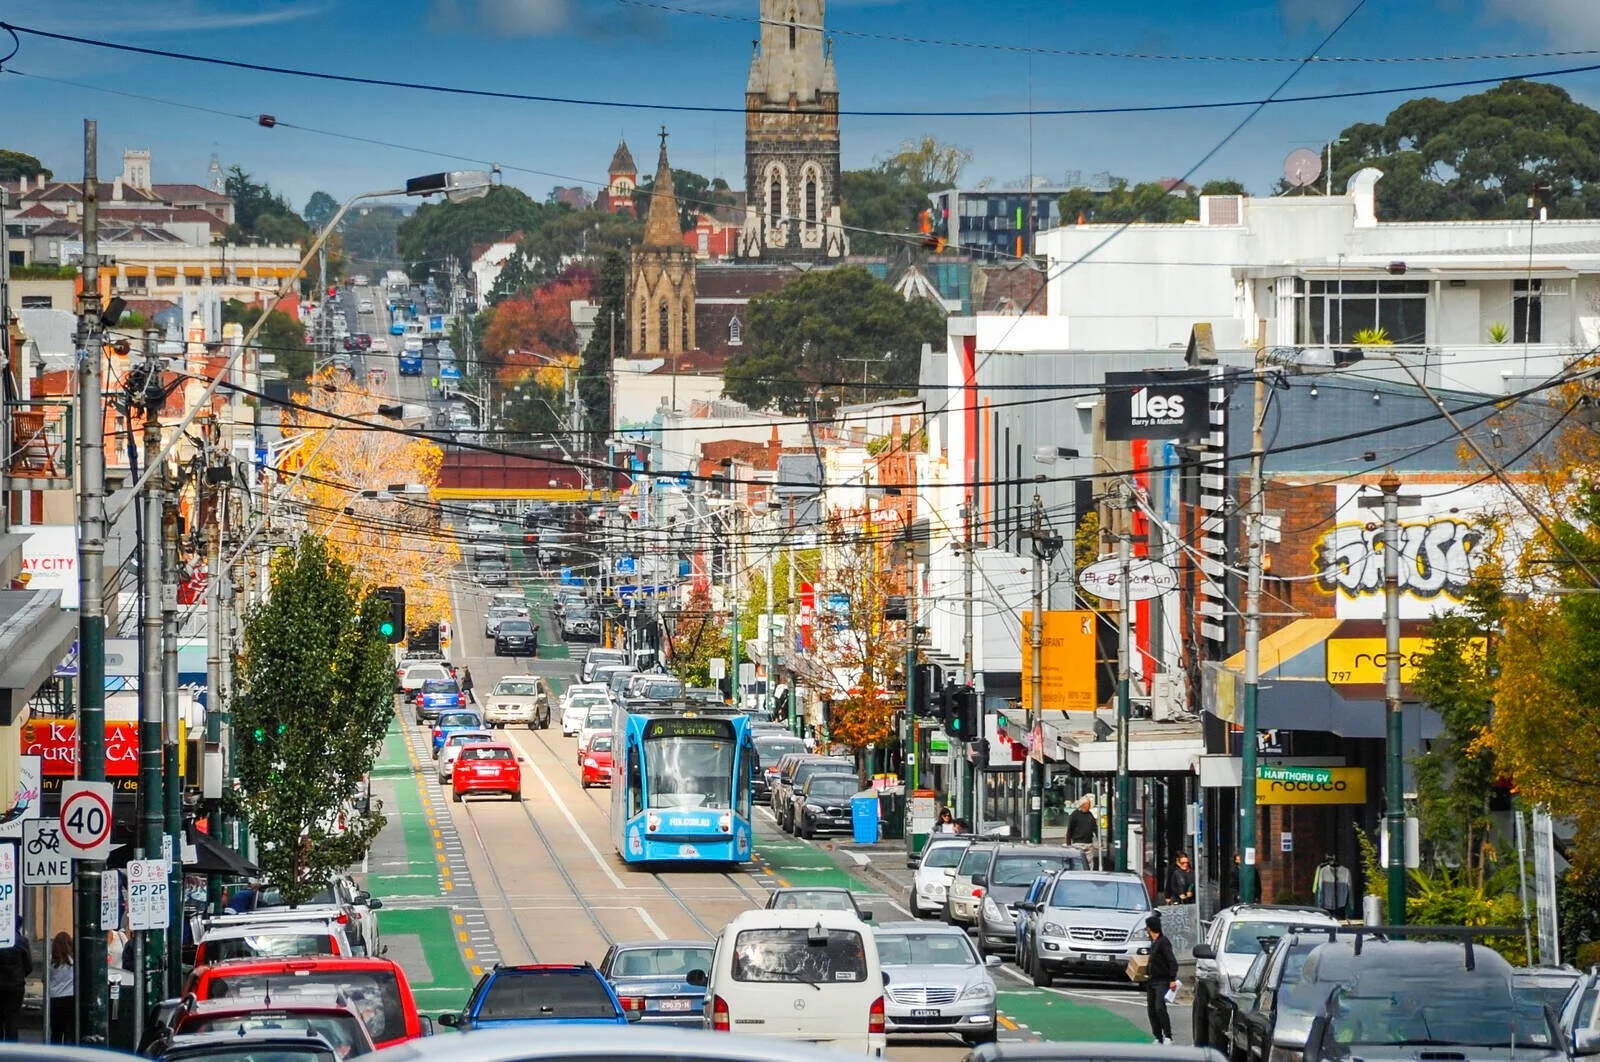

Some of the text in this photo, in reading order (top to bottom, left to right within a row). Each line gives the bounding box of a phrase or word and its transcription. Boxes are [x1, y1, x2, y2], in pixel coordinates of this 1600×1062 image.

[871, 509, 897, 521] BAR
[22, 558, 74, 570] AY CITY
[1331, 671, 1351, 681] 797
[1264, 769, 1329, 783] HAWTHORN GV
[1271, 780, 1347, 792] rococo
[67, 807, 104, 835] 40
[27, 861, 68, 876] LANE
[131, 884, 167, 896] 2P 2P
